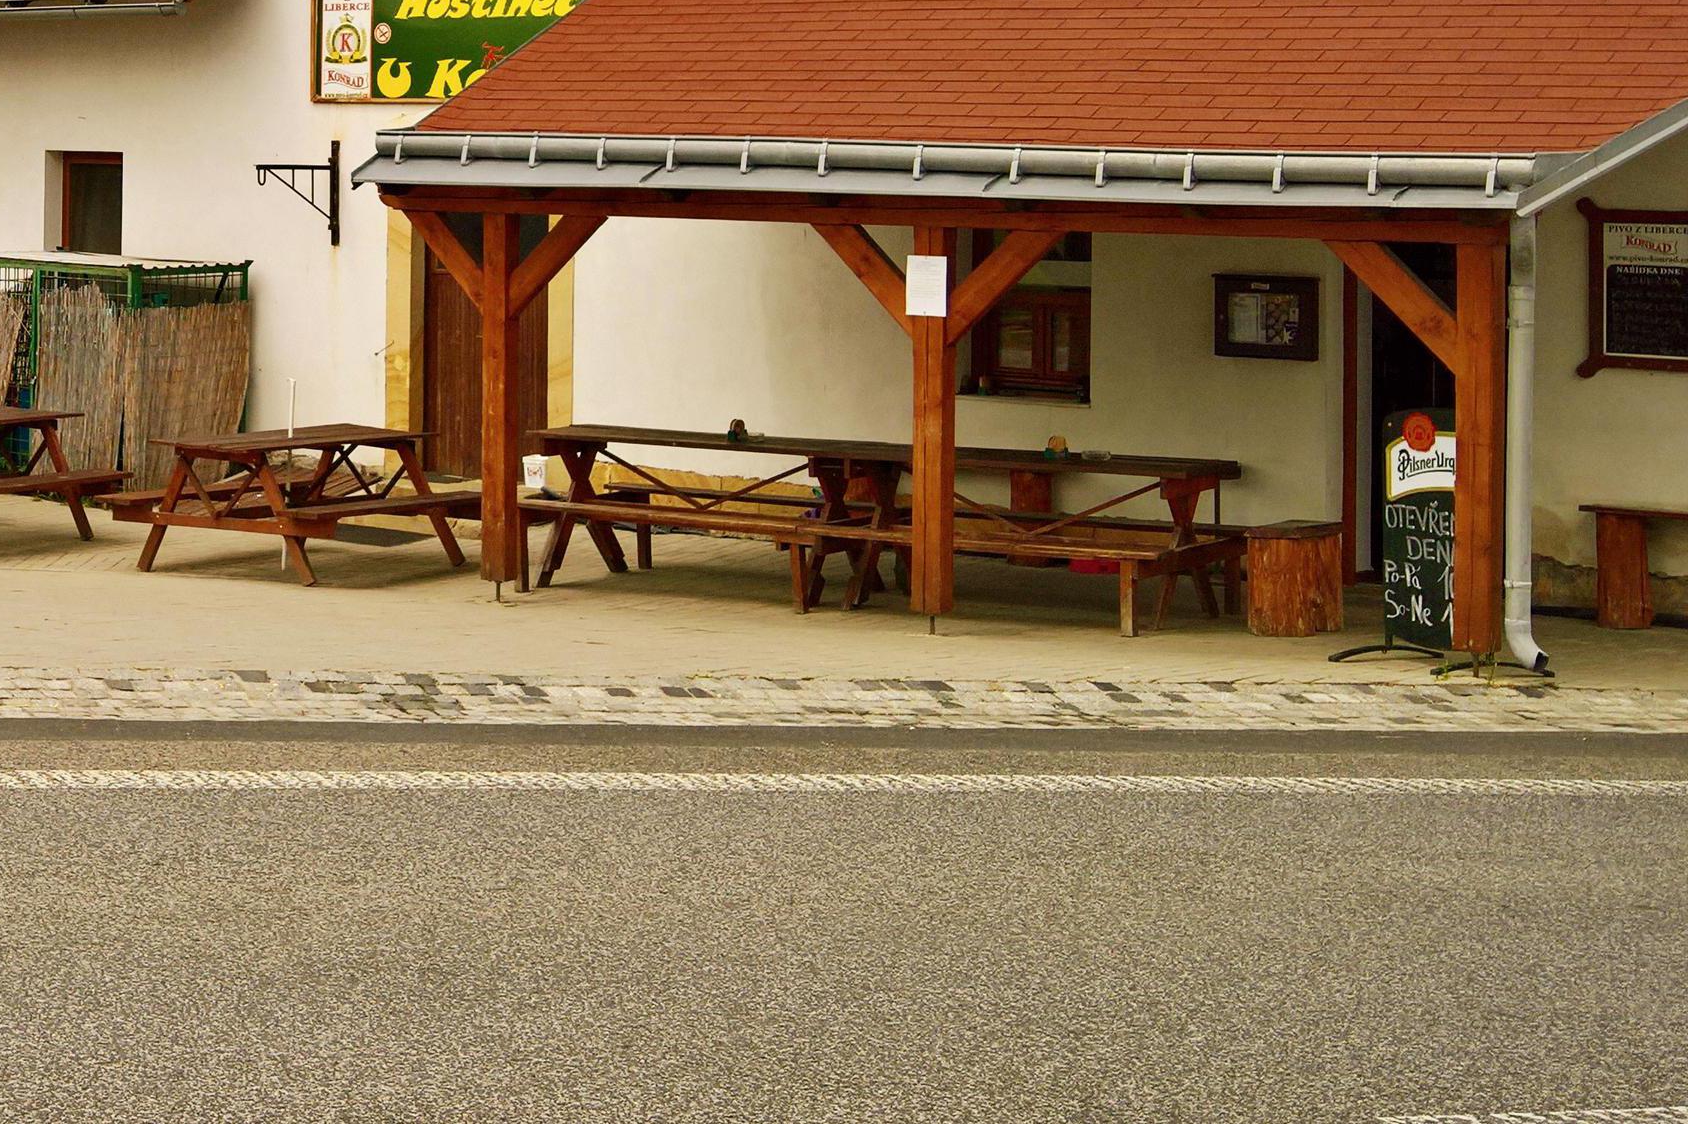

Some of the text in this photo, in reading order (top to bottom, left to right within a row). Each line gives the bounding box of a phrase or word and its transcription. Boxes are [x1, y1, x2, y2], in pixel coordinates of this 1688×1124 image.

[325, 3, 370, 12] LIBERCE
[340, 32, 353, 52] K
[327, 70, 364, 88] KONRAD
[377, 57, 412, 98] U
[1608, 225, 1632, 233] PIVO
[1626, 235, 1672, 253] KONRAD
[1397, 449, 1436, 480] Pilsner
